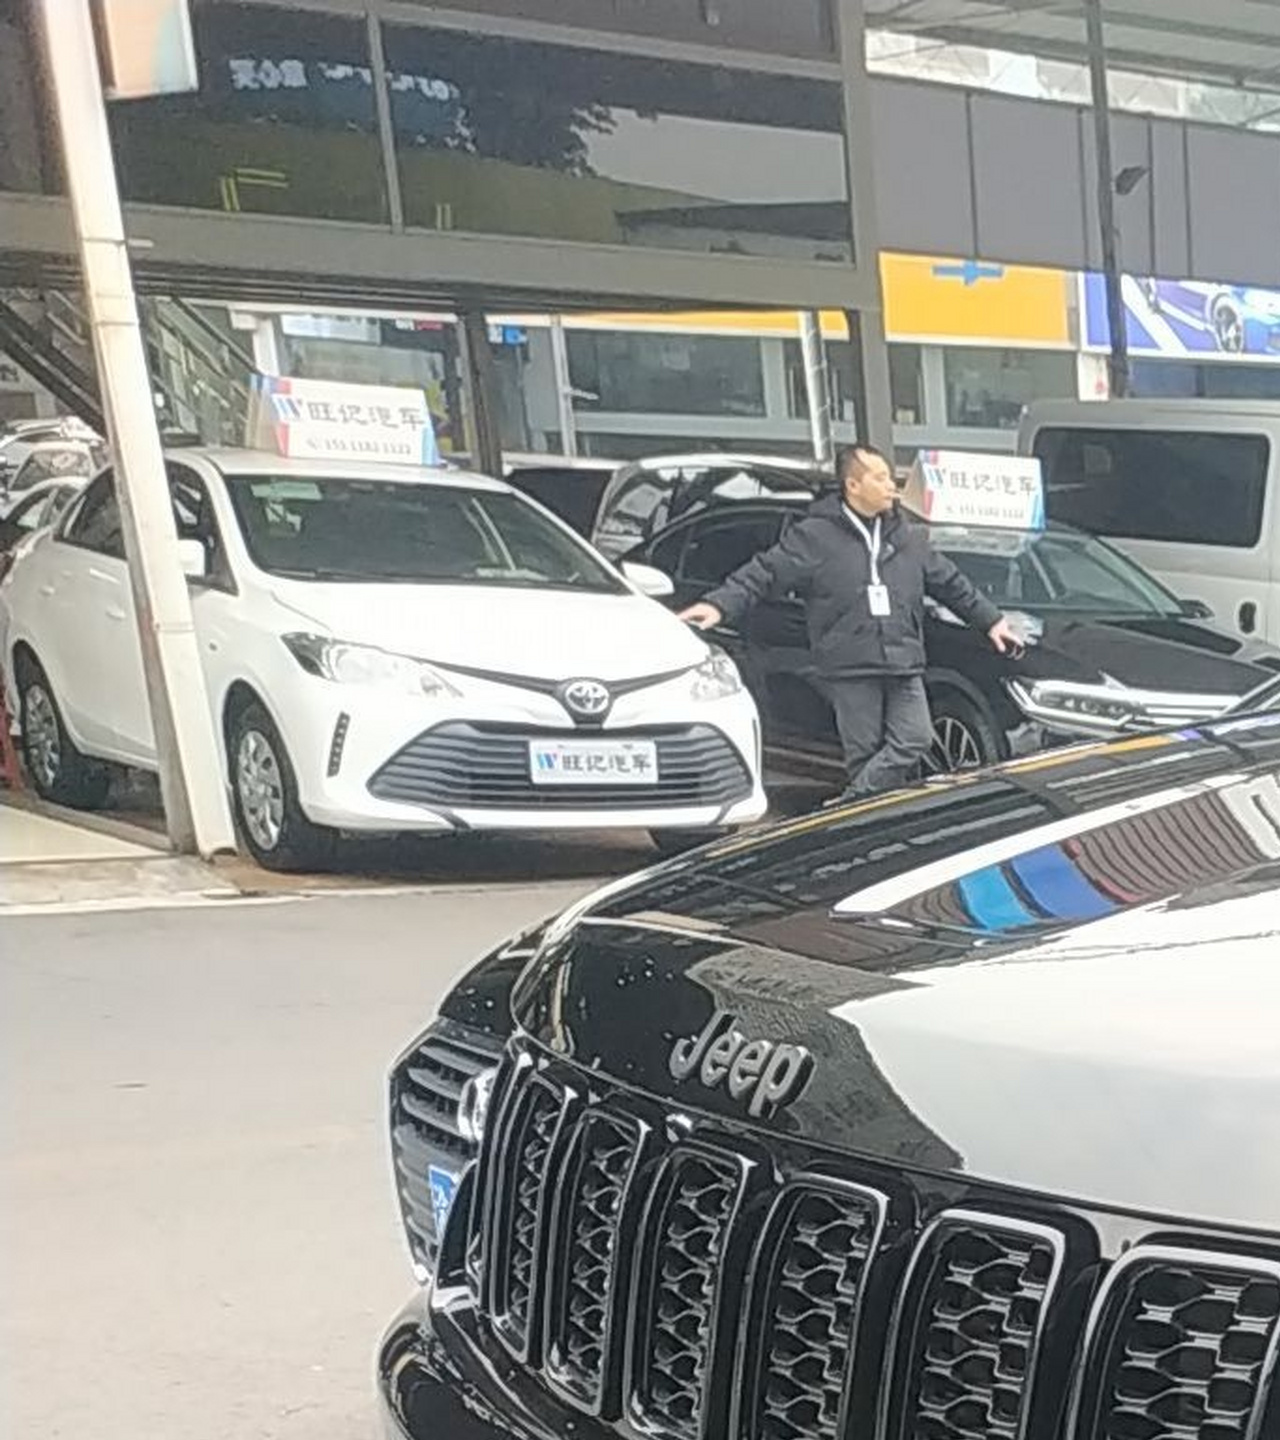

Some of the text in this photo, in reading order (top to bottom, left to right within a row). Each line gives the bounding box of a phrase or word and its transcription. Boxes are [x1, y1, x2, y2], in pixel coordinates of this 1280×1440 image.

[307, 401, 426, 431] 旺记汽车
[950, 471, 1036, 496] 旺记汽车
[562, 754, 652, 774] 旺记汽车
[669, 1009, 817, 1119] Jeep
